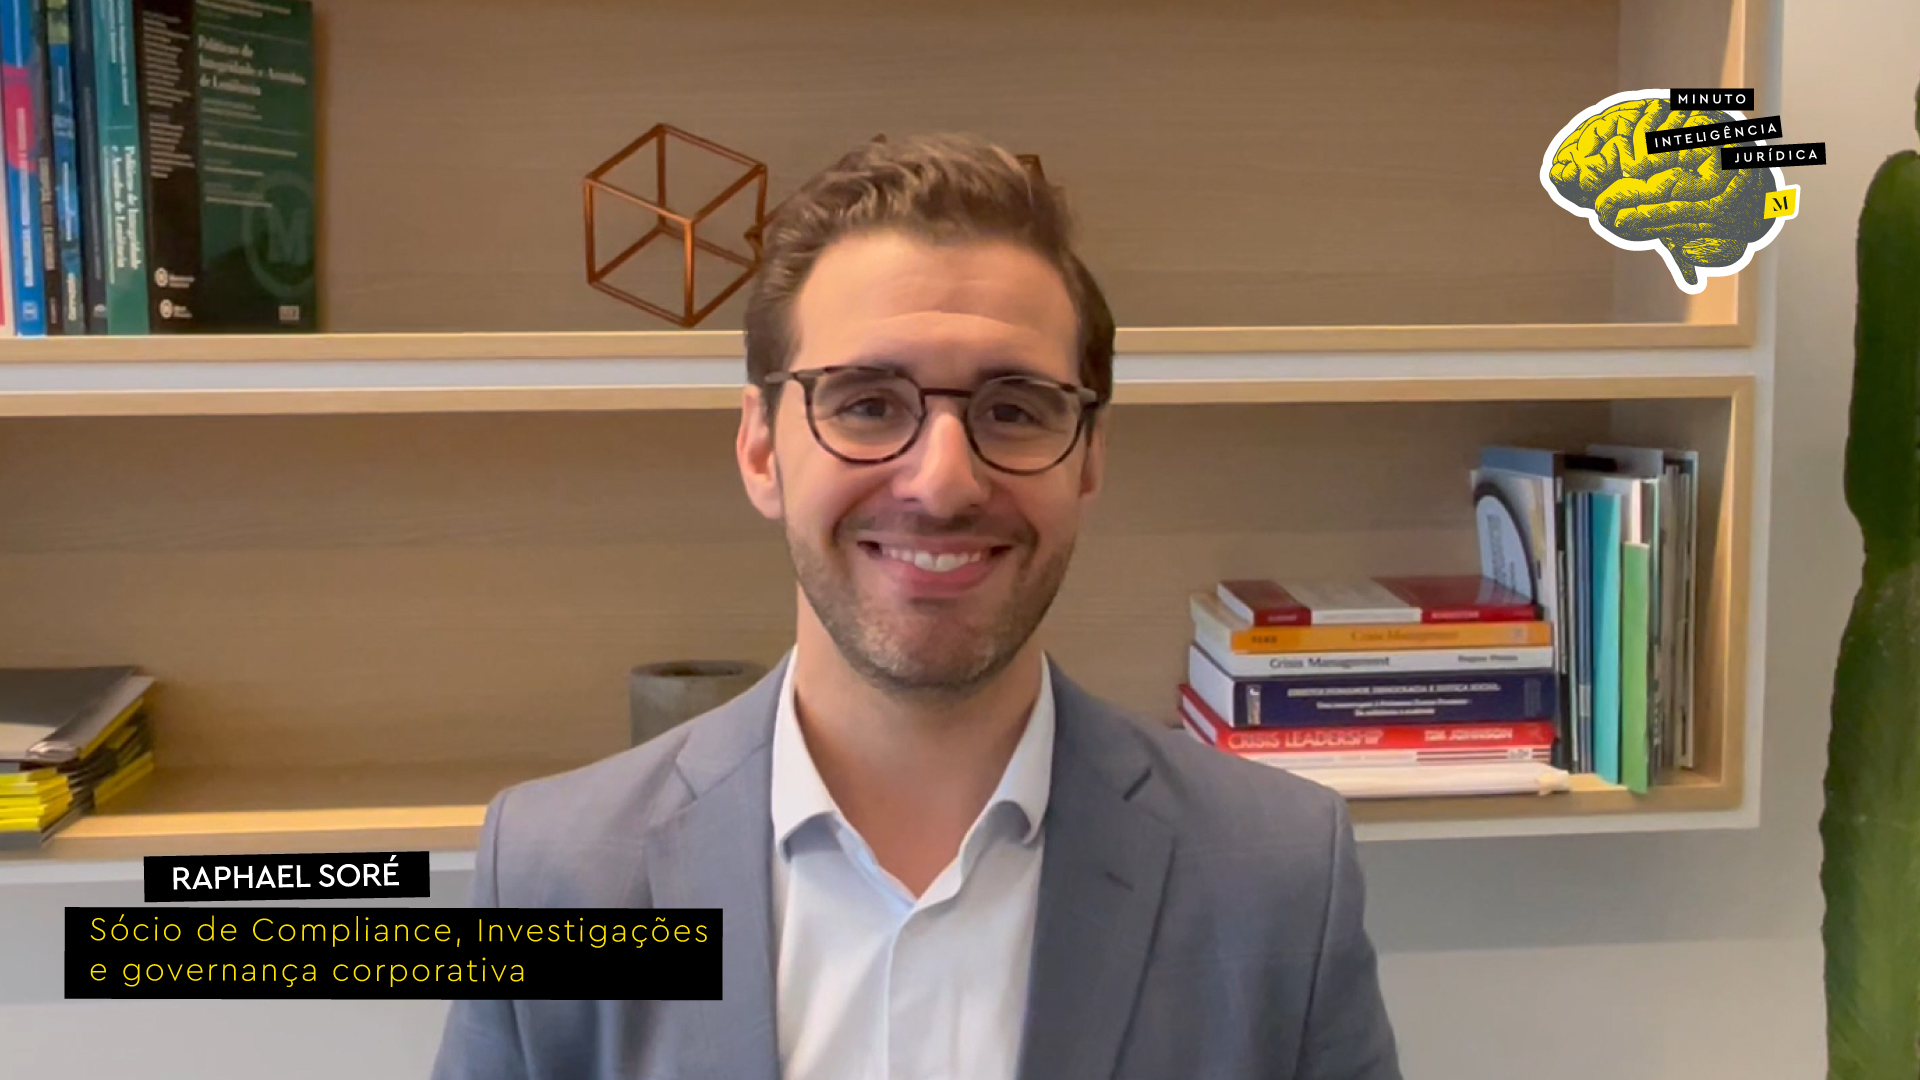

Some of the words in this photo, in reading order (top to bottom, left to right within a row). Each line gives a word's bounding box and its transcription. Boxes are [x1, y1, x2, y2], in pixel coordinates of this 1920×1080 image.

[1269, 658, 1304, 669] Crisis
[1307, 656, 1390, 670] Management
[1228, 733, 1280, 749] CRISIS
[1284, 730, 1385, 748] LEADERSHIP
